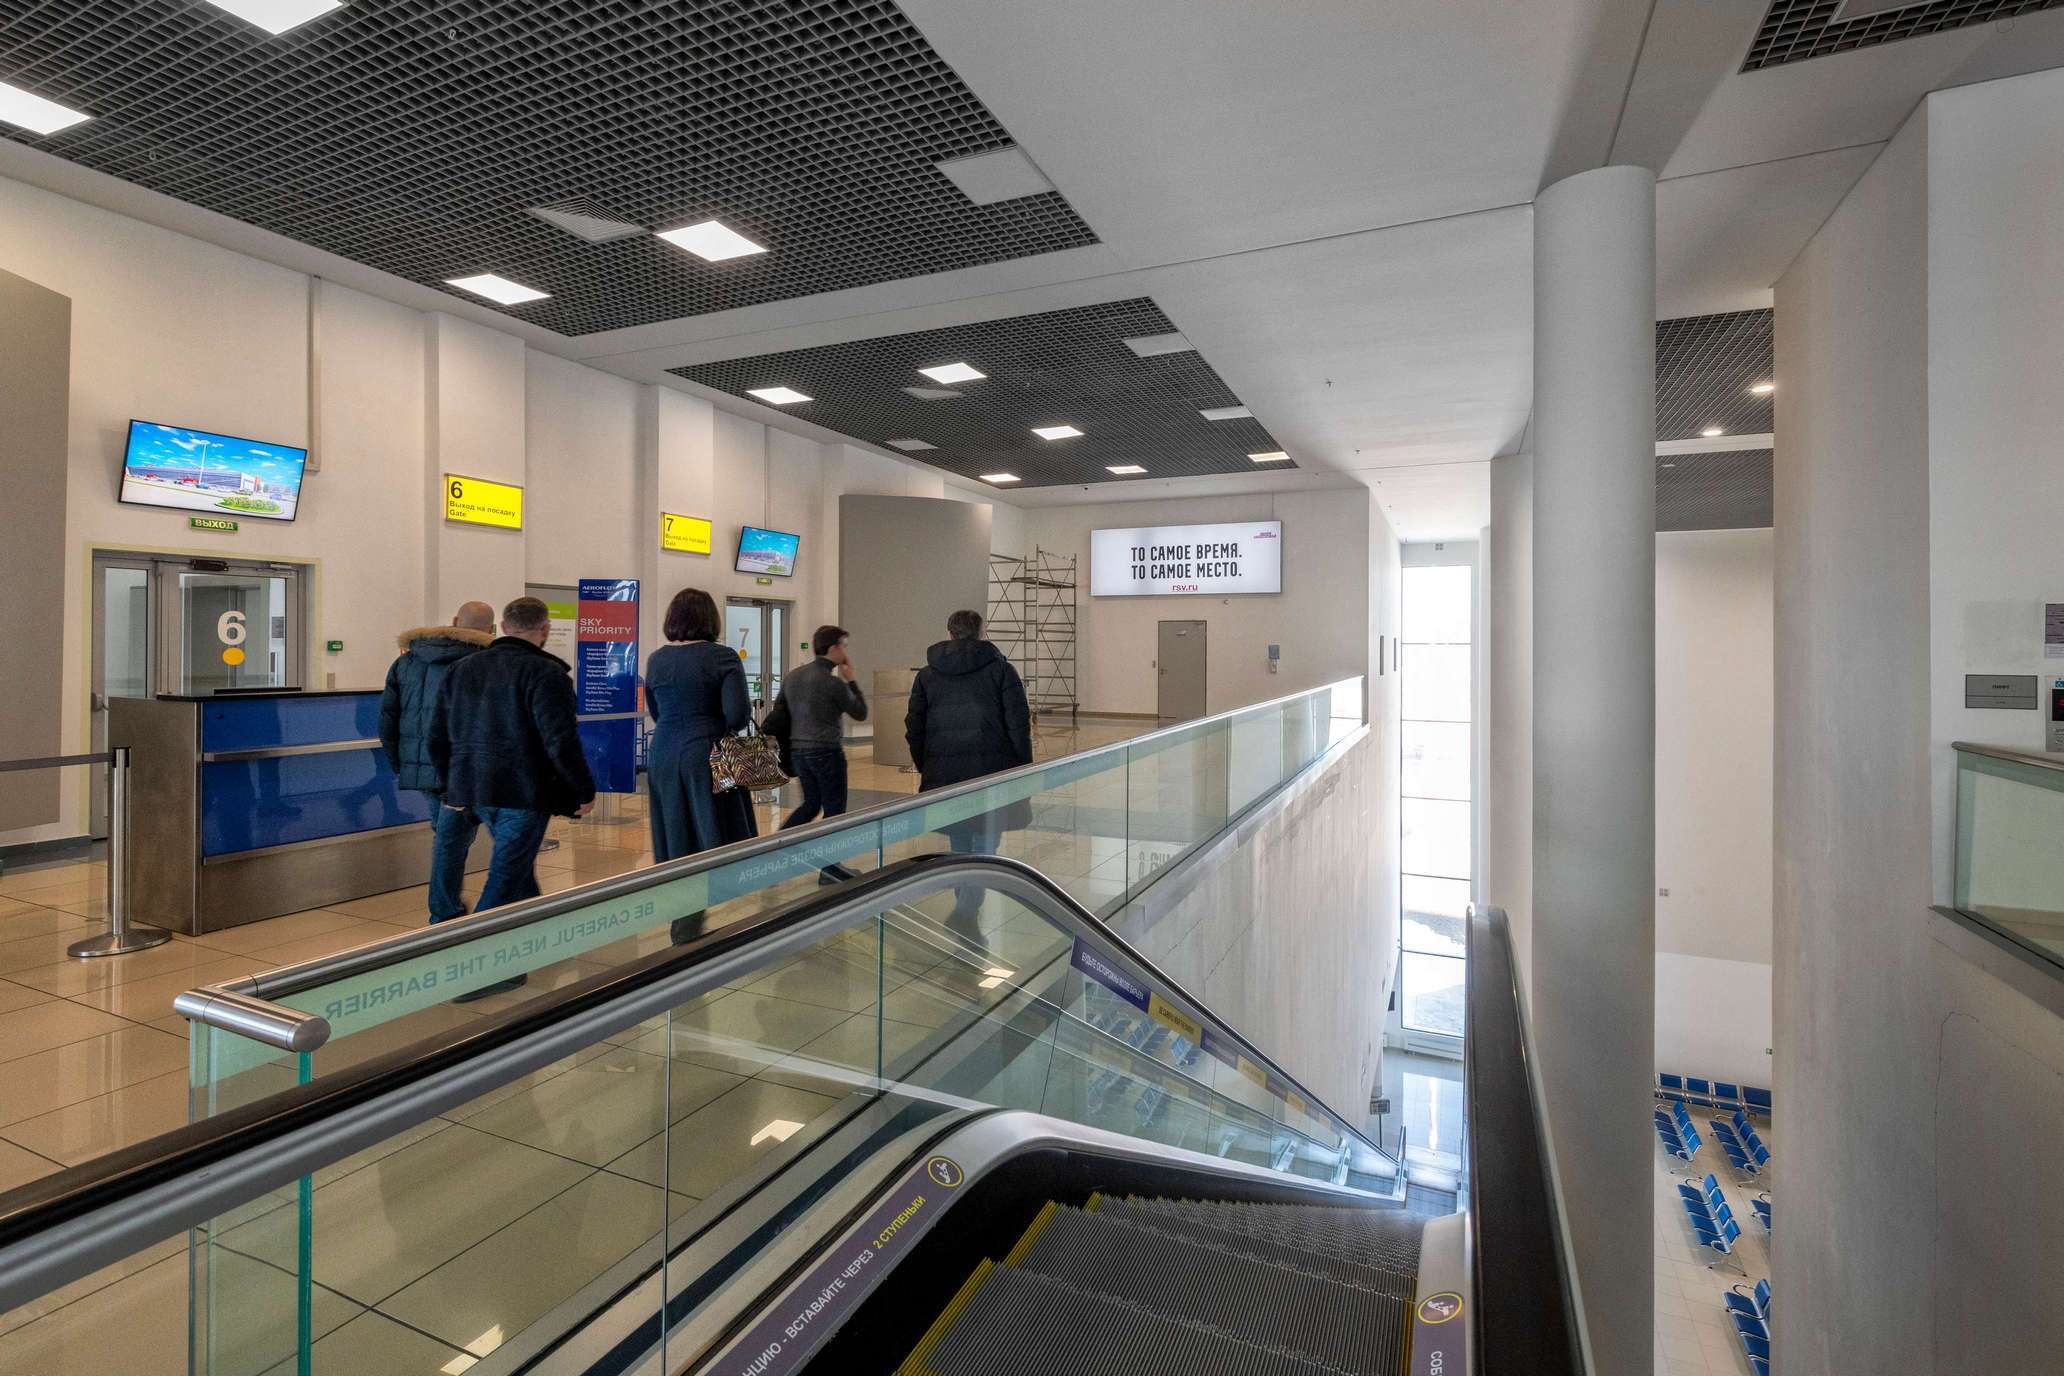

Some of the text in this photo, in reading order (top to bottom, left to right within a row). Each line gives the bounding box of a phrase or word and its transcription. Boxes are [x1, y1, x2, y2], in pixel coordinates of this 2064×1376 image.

[450, 481, 463, 499] 6
[449, 500, 475, 511] Выход
[195, 519, 234, 530] ВЫХОД
[666, 517, 674, 531] 7
[1131, 543, 1243, 562] ТО САМОЕ ВРЕМЯ.
[1131, 562, 1242, 580] ТО САМОЕ МЕСТО.
[1172, 584, 1198, 592] rsv.ru
[217, 610, 247, 646] 6
[579, 626, 632, 634] PRIORITY
[580, 617, 602, 626] SKY
[739, 628, 750, 648] 7
[785, 1278, 847, 1340] ВСТАВАЙТЕ
[841, 1249, 874, 1281] ЧЕРЕЗ
[872, 1239, 882, 1250] 2
[879, 1195, 927, 1243] СТУПЕНЬКИ
[1431, 1351, 1443, 1376] СОБ
